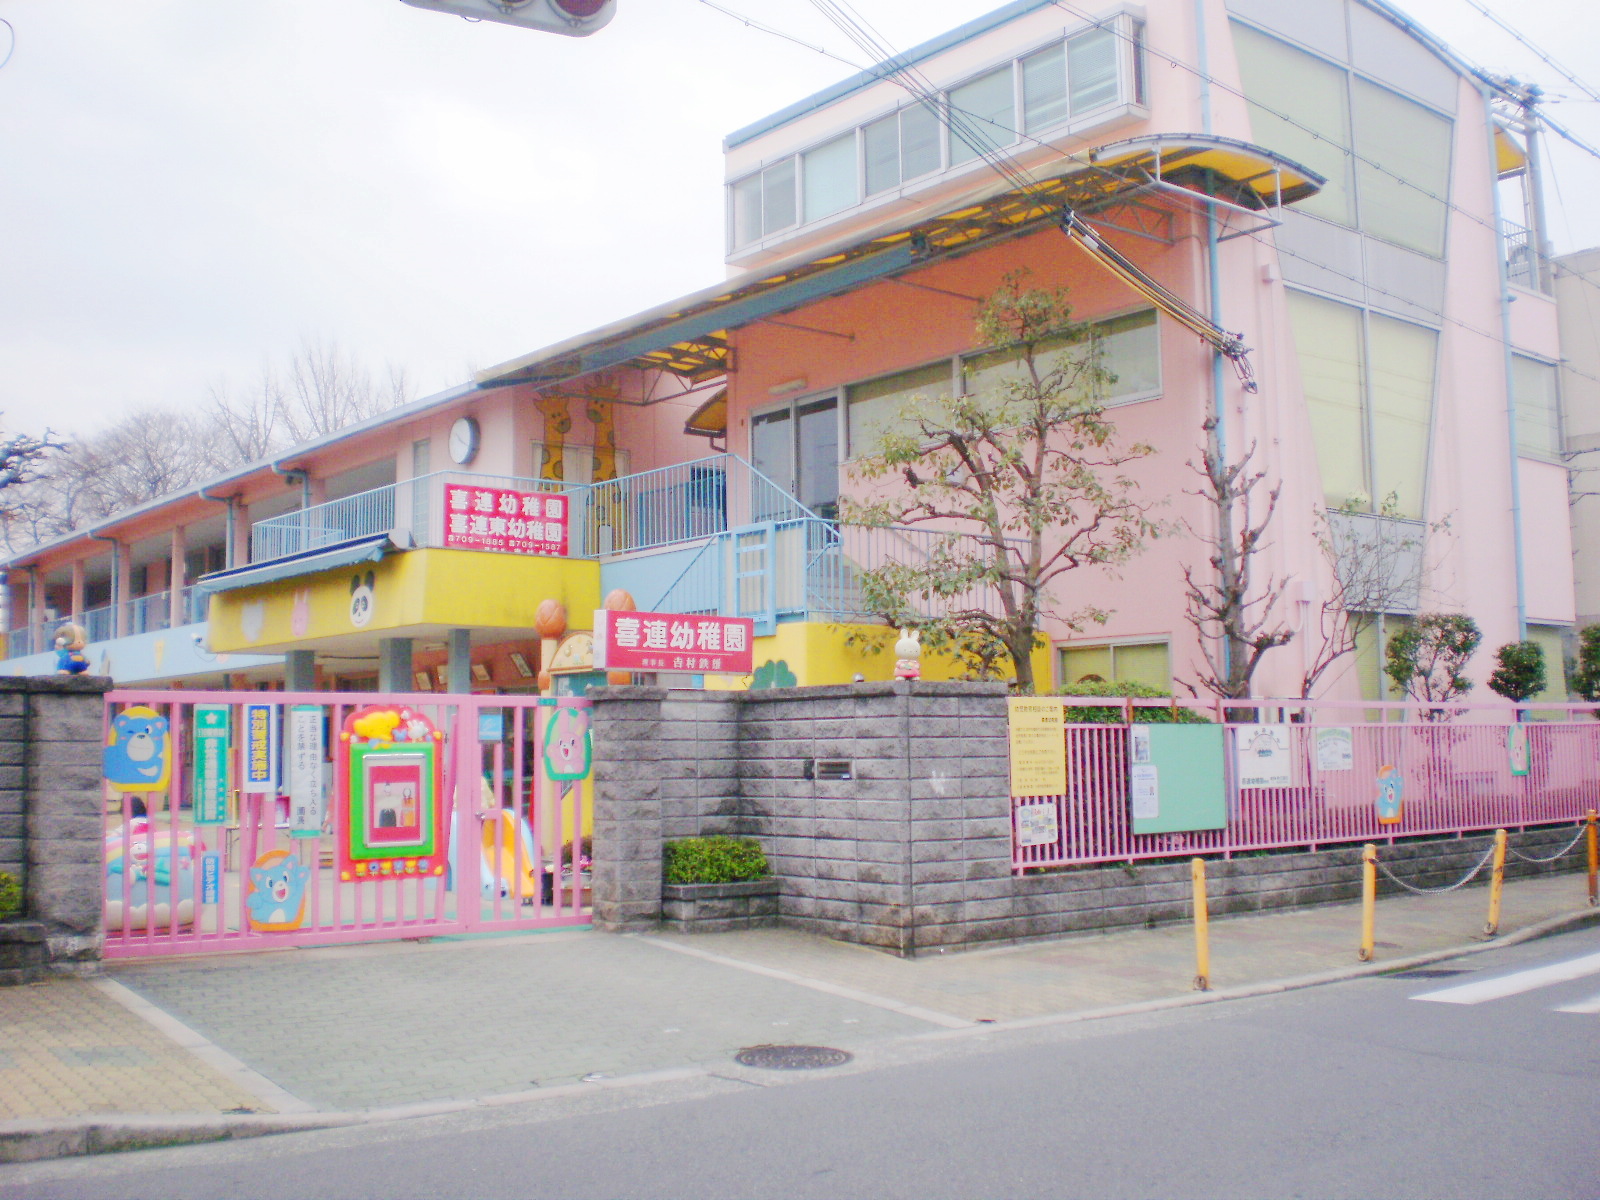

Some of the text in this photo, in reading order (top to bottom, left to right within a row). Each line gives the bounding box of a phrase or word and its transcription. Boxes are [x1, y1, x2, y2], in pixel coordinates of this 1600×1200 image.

[449, 489, 562, 518] 喜連幼稚園
[449, 513, 562, 542] 喜連東幼稚園
[615, 617, 746, 652] 喜連幼稚園
